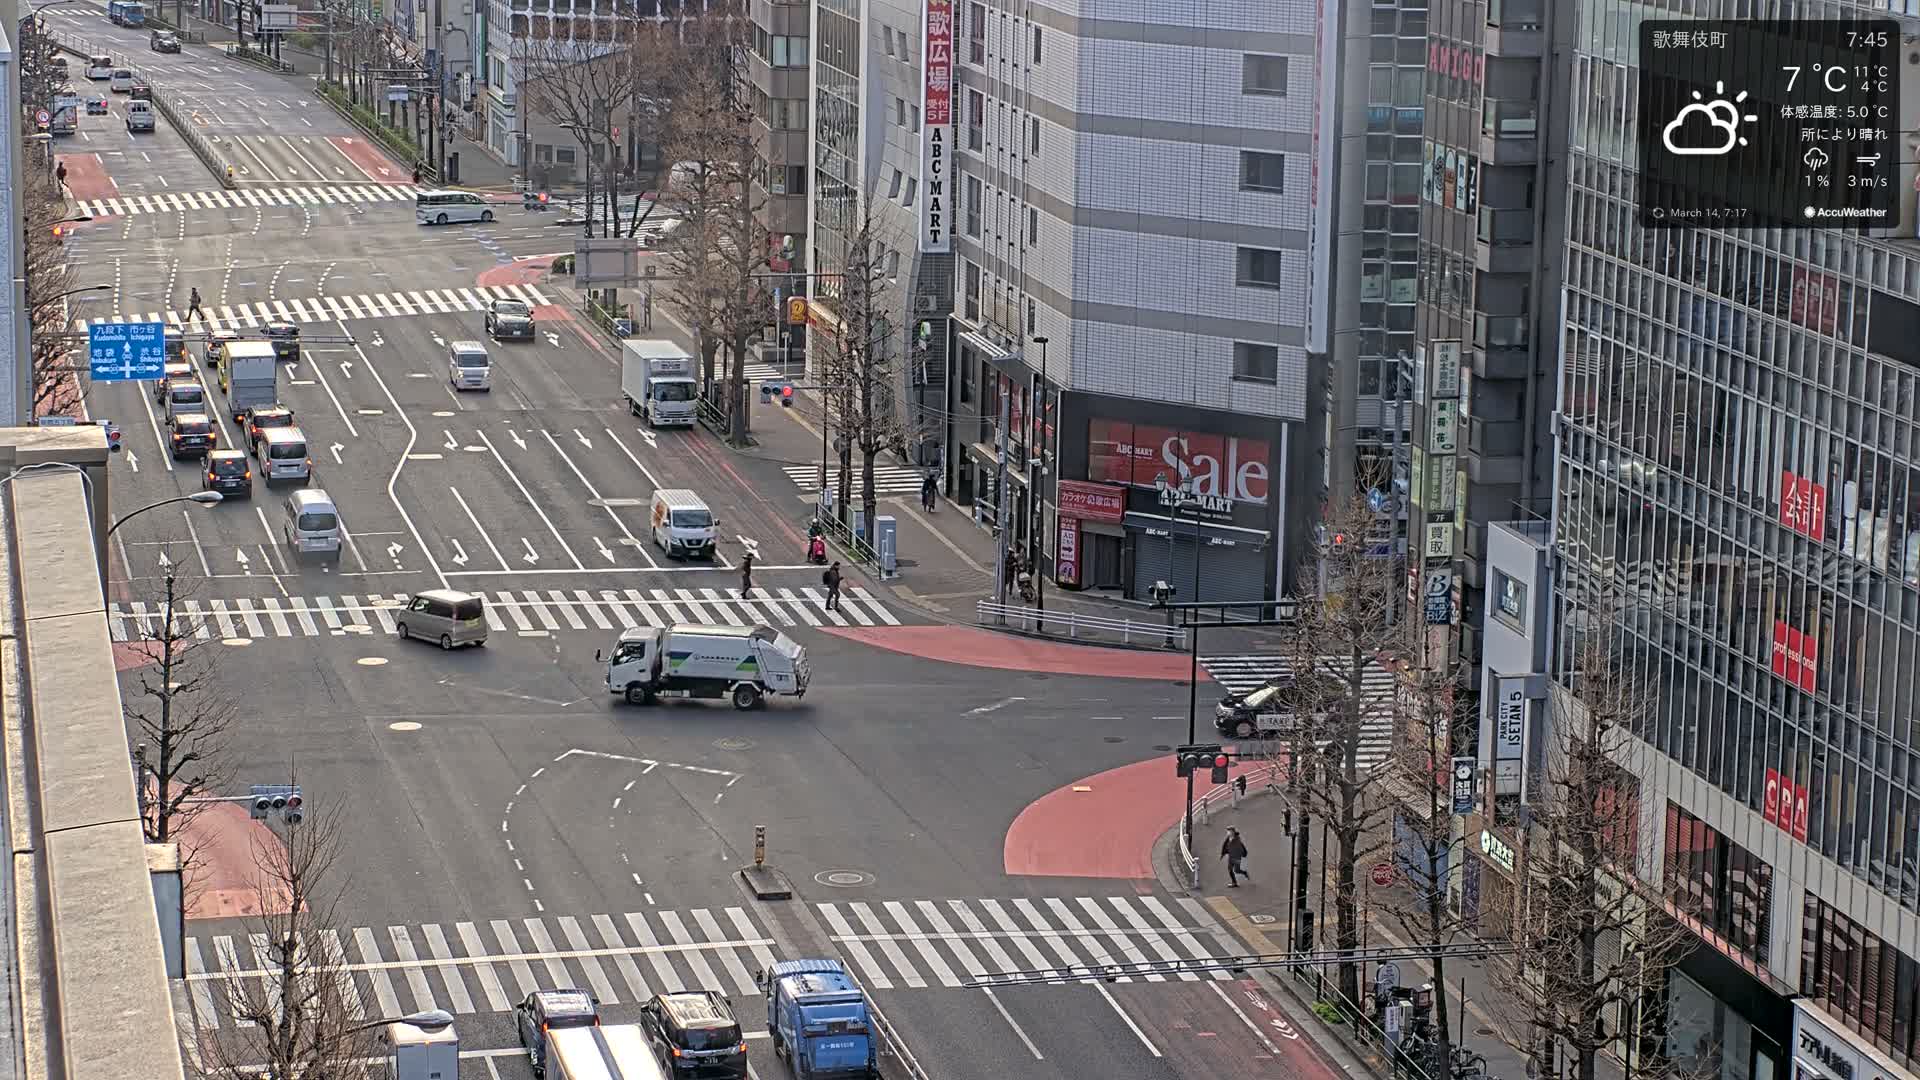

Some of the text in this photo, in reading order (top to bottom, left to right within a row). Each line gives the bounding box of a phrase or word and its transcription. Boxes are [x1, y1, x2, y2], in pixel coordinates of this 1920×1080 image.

[928, 11, 950, 92] 歌広場
[1429, 42, 1483, 85] AMIGO
[927, 99, 949, 110] 受付
[928, 111, 949, 120] 5F
[96, 325, 124, 334] 九段下
[1116, 442, 1153, 455] ABCMART
[1162, 435, 1268, 501] Sale
[1435, 514, 1446, 522] 7F
[1785, 482, 1821, 531] 会計
[1430, 526, 1443, 553] 買取
[1500, 702, 1508, 739] PARK CITY
[1508, 691, 1522, 746] ISETAN 5
[1767, 779, 1805, 830] CPA
